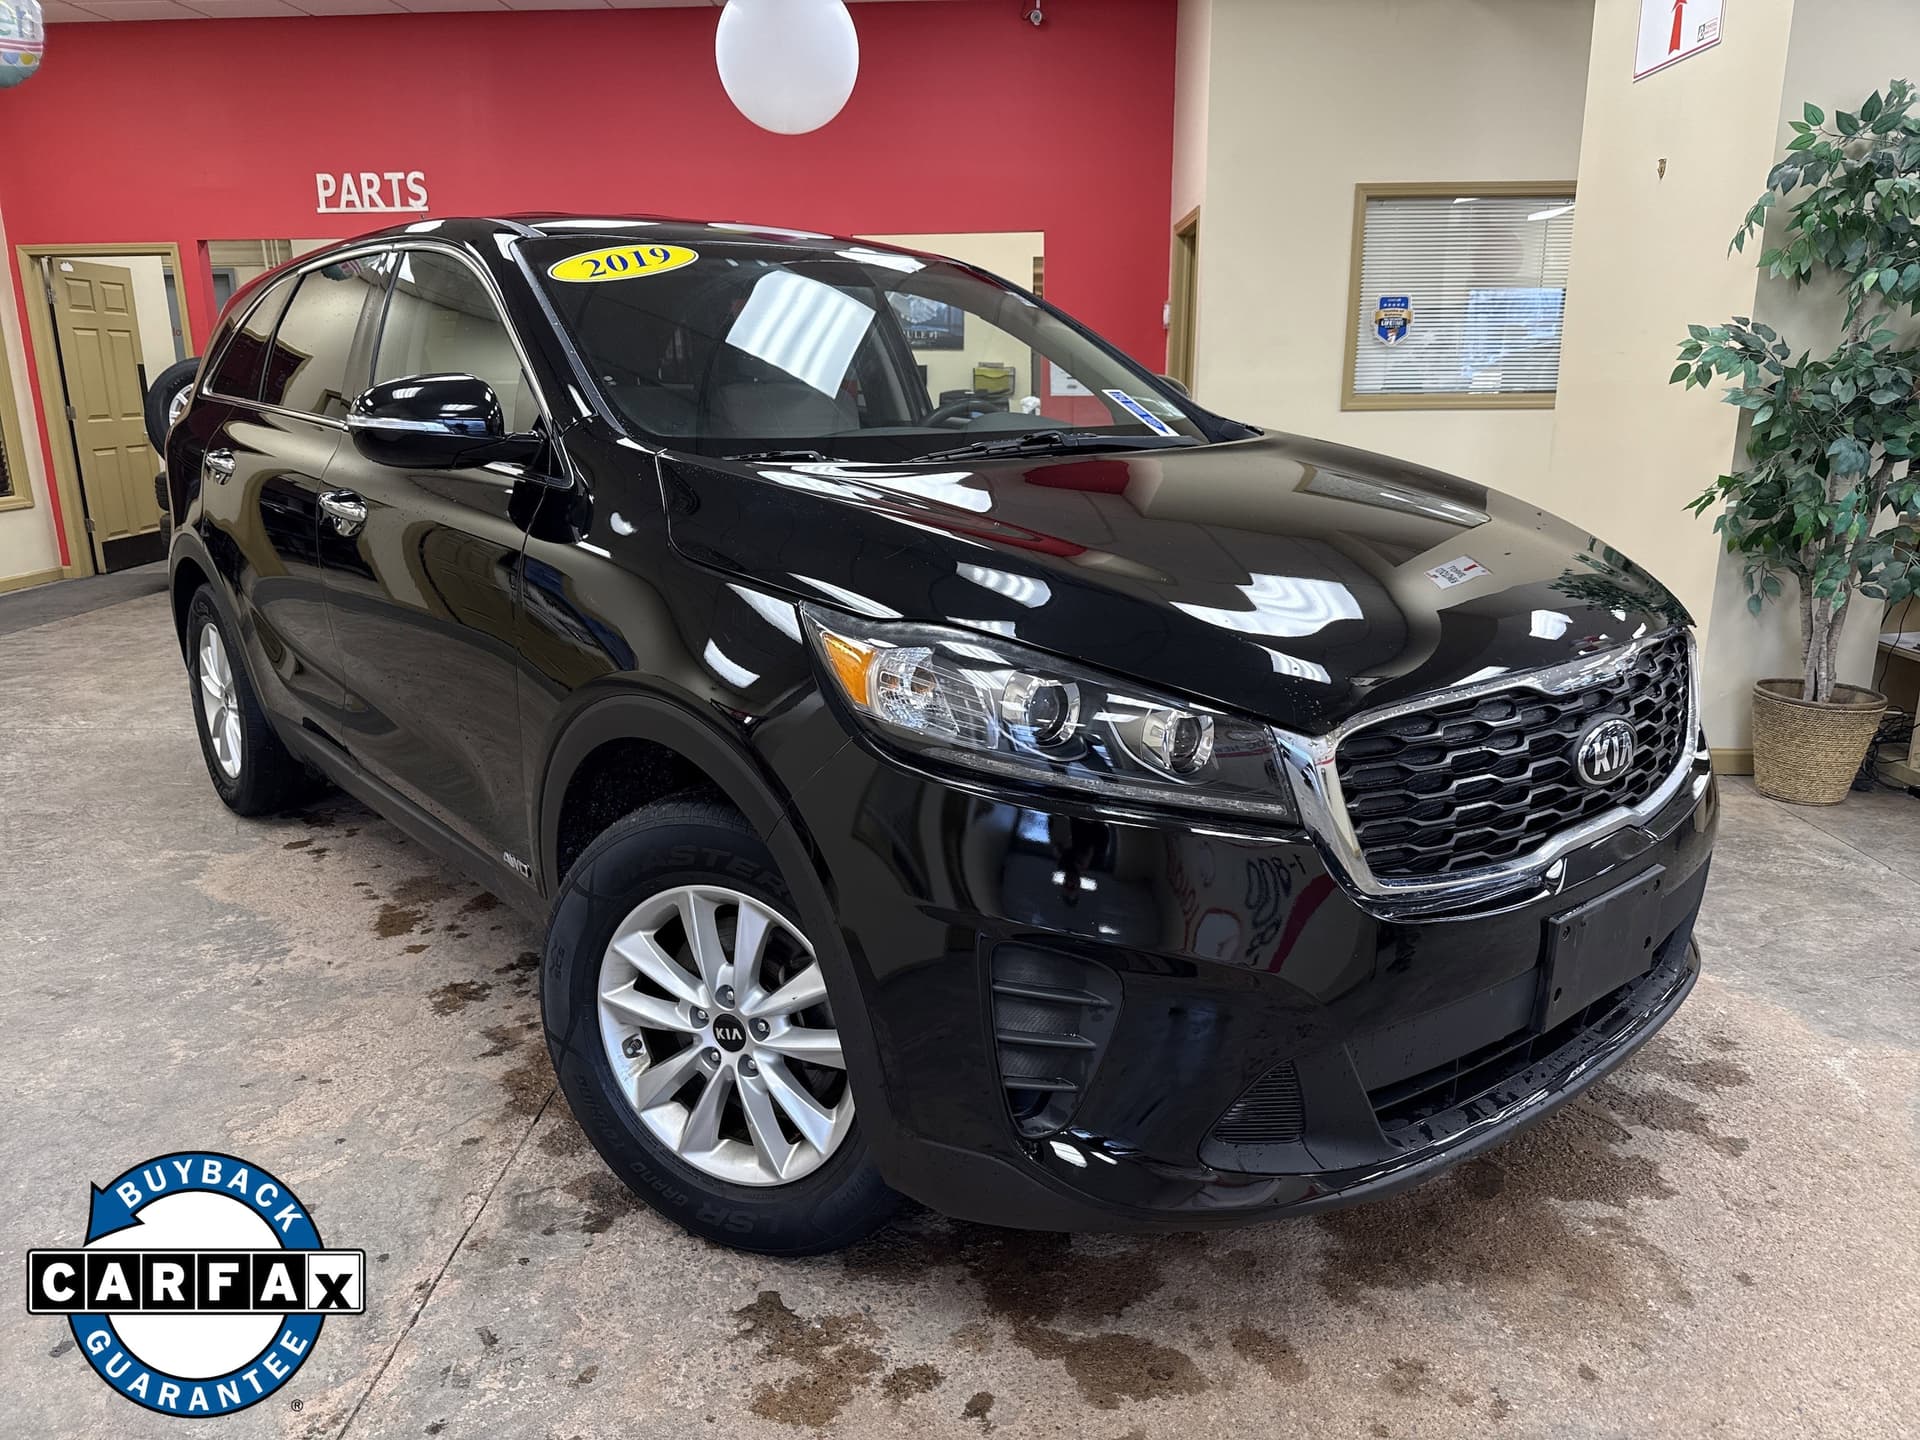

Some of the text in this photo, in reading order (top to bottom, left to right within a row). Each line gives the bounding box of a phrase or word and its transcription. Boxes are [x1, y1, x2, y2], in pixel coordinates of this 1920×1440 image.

[316, 171, 429, 212] PARTS
[580, 246, 672, 279] 2019
[902, 330, 928, 339] ULE
[1592, 731, 1633, 776] KIA
[503, 850, 530, 878] AWD
[715, 1027, 743, 1041] KIA
